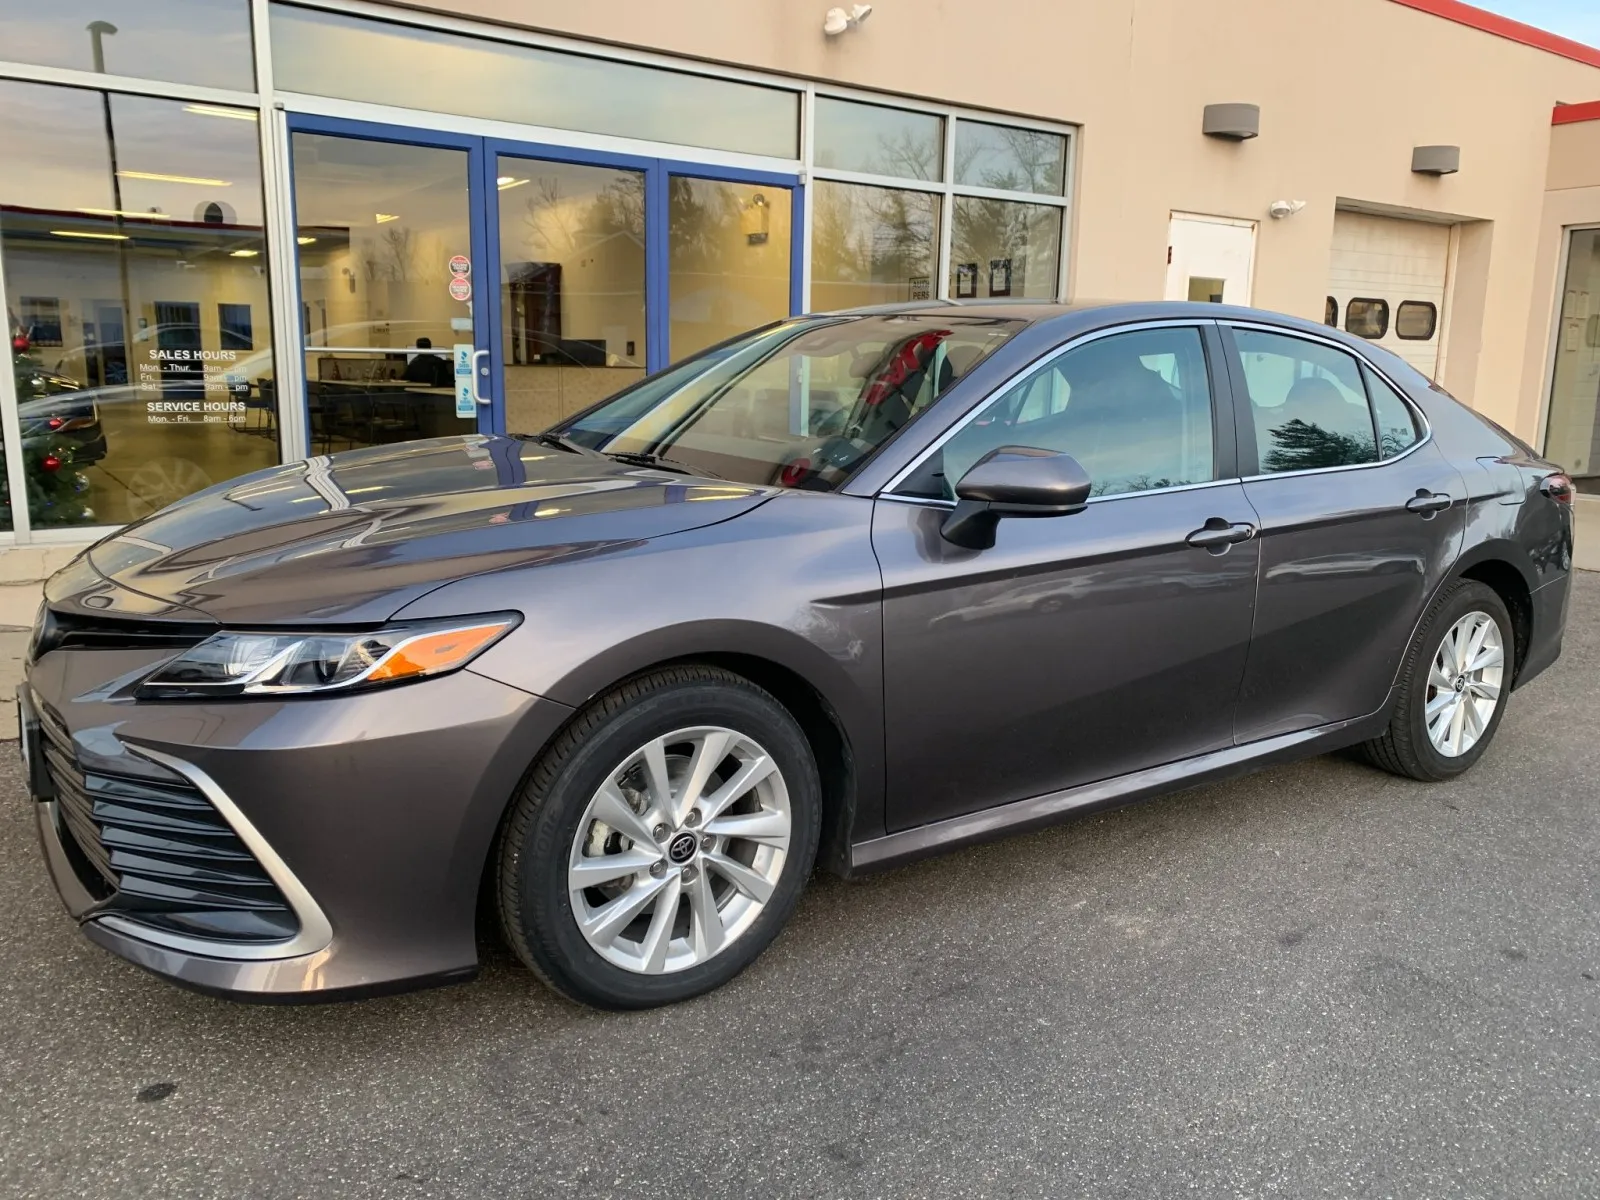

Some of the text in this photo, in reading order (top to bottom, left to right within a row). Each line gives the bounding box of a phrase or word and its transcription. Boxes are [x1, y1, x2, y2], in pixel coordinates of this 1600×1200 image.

[149, 350, 236, 360] SALES HOURS
[139, 363, 161, 371] Mon.
[168, 363, 191, 372] Thur.
[140, 373, 154, 381] Fri.
[235, 384, 248, 392] pm
[147, 402, 246, 411] SERVICE HOURS
[147, 415, 169, 423] Mon.
